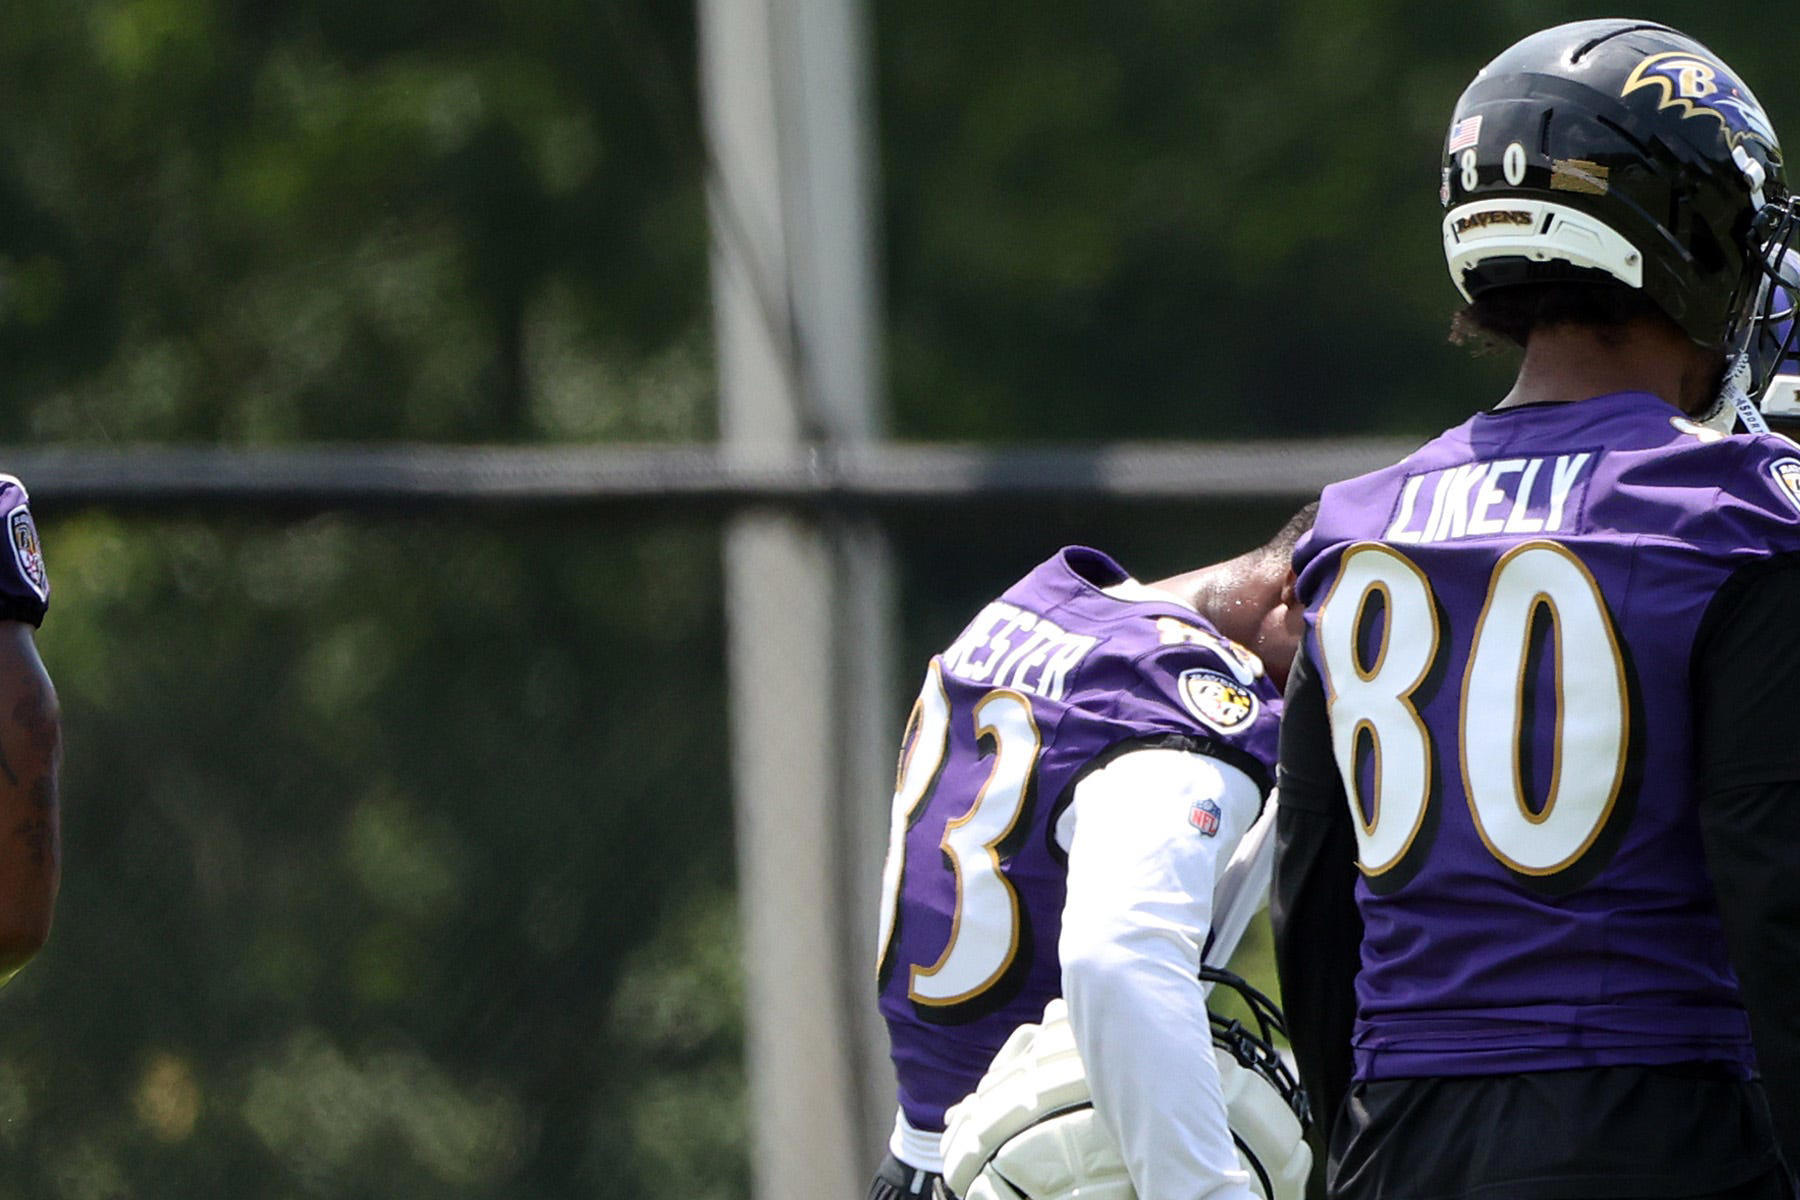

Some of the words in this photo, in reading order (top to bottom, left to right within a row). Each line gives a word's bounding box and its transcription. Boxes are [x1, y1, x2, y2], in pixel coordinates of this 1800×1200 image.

[1655, 60, 1719, 98] B
[1386, 453, 1591, 544] LIKELY
[1317, 541, 1629, 877] 80
[1192, 809, 1217, 833] NFL
